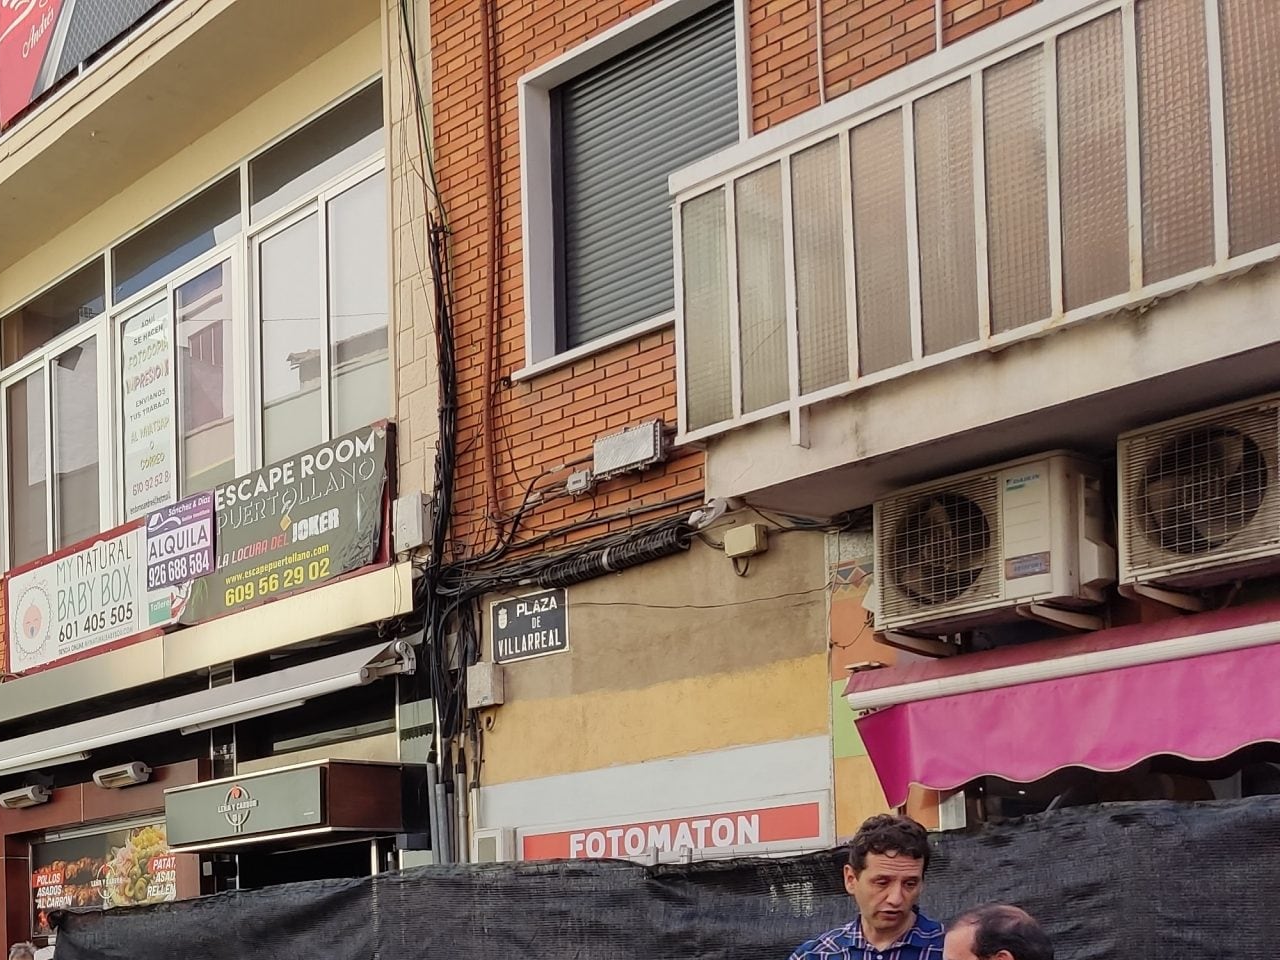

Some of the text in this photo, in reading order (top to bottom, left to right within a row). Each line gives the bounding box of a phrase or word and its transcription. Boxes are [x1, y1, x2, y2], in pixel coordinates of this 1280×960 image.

[133, 323, 164, 346] SE HACEN
[130, 397, 170, 422] TUS TRABAJO
[140, 452, 166, 471] CORREO
[215, 460, 295, 513] ESCAPE
[301, 430, 375, 479] ROOM
[145, 477, 153, 491] 92
[216, 457, 376, 536] PUERTOLLANO
[168, 503, 192, 516] Sánchez
[198, 495, 211, 506] Díaz
[149, 525, 209, 561] ALQUILA
[217, 507, 340, 569] LA LOCURA DEL JOKER
[56, 535, 132, 587] MY NATURAL
[148, 550, 210, 588] 926 688 584
[225, 544, 330, 586] www.escapepuertollano.com
[57, 564, 133, 623] BABY BOX
[225, 557, 331, 607] 609 56 29 02
[58, 602, 133, 643] 601 405 505
[516, 596, 558, 618] PLAZA
[531, 616, 541, 630] DE
[498, 628, 562, 657] VILLARREAL
[569, 813, 760, 861] FOTOMATON
[36, 872, 61, 886] POLLOS
[153, 856, 176, 870] PATAT
[36, 885, 63, 898] ASADOS
